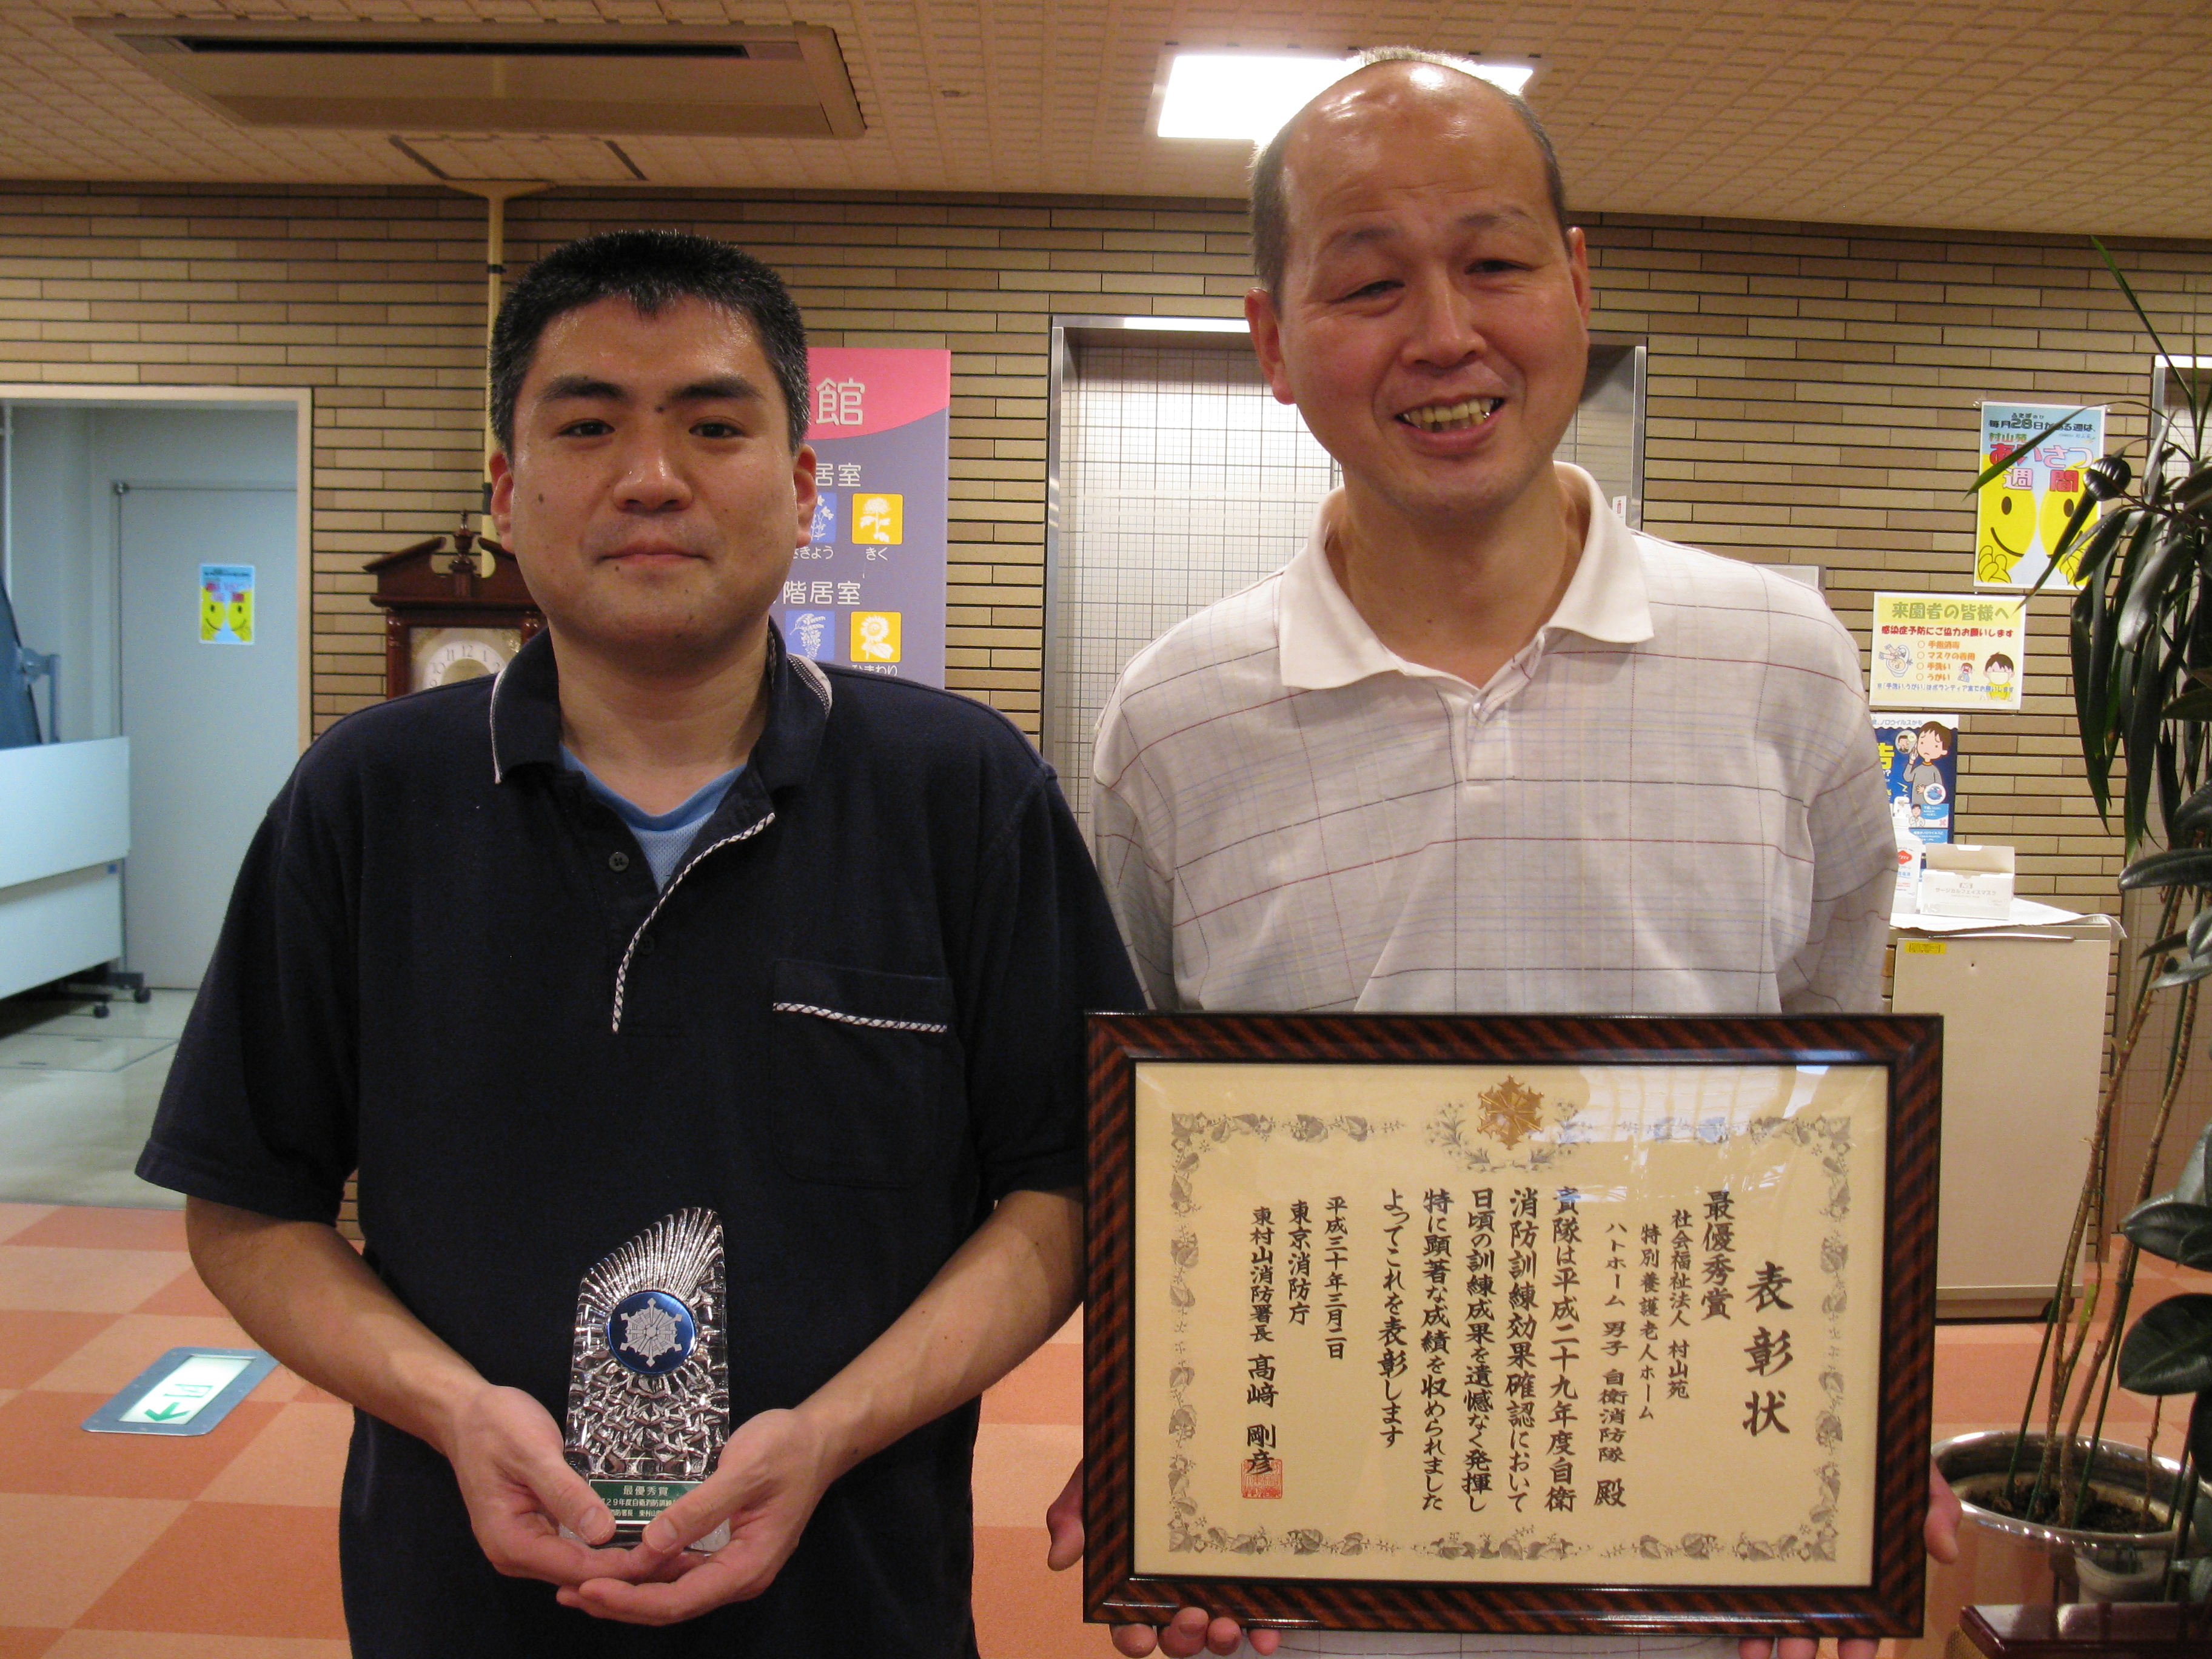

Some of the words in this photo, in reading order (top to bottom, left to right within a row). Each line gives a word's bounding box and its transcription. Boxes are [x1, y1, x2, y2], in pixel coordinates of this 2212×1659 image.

[816, 378, 865, 426] 館
[865, 546, 888, 561] きく
[1882, 626, 2014, 638] 感染症予防にご協力お願いします
[1892, 602, 2009, 622] 来園者の皆様へ
[1249, 1205, 1275, 1342] 東村山消防署長
[1287, 1199, 1312, 1326] 東京消防庁
[1324, 1195, 1349, 1360] 平成三十年三月二日
[1604, 1223, 1628, 1307] ハトホーム
[1669, 1208, 1694, 1327] 社会福祉法人
[1700, 1190, 1735, 1321] 最優秀賞
[1376, 1188, 1410, 1448] よってこれを表彰します
[1420, 1188, 1455, 1511] 特に顕著な成績を収められました
[1461, 1187, 1497, 1513] 日頃の訓練成果を遺憾なく発揮し
[1504, 1187, 1539, 1513] 消防訓練効果確認において
[1600, 1321, 1629, 1356] 男子
[1638, 1223, 1662, 1420] 特別養護老人ホーム
[1667, 1339, 1690, 1399] 村山苑
[1741, 1260, 1794, 1438] 表彰状
[1245, 1423, 1276, 1475] 剛彦
[1598, 1368, 1629, 1463] 自衛消防隊
[623, 1485, 669, 1497] 最優秀賞
[1594, 1478, 1626, 1507] 殿
